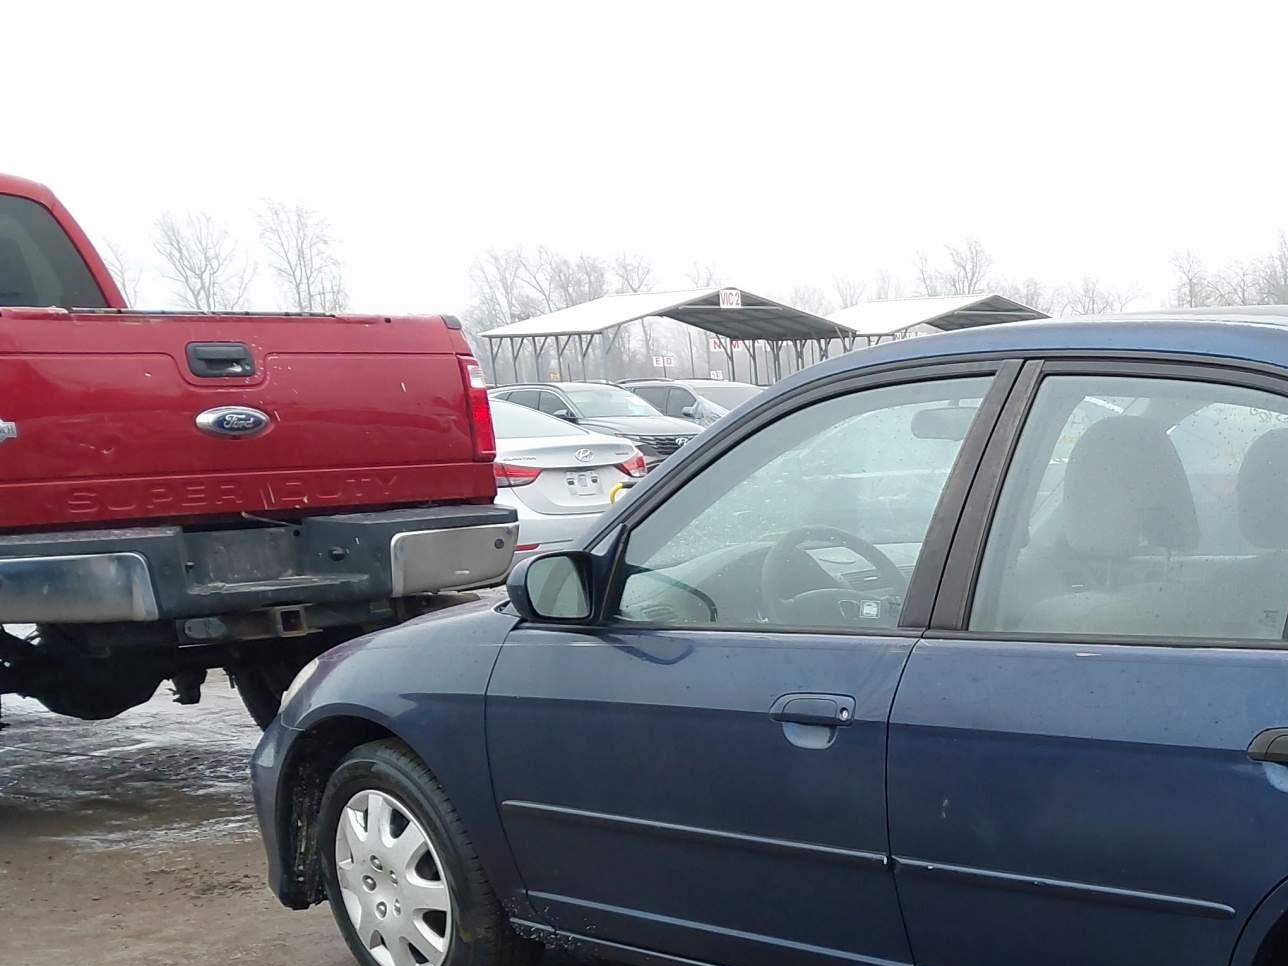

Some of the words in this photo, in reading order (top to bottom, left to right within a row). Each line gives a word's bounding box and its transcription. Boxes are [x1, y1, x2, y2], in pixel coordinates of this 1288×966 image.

[720, 291, 733, 306] VIC
[734, 291, 740, 305] 2
[223, 414, 254, 428] Ford
[67, 484, 243, 513] SUPER
[280, 475, 398, 502] DUTY
